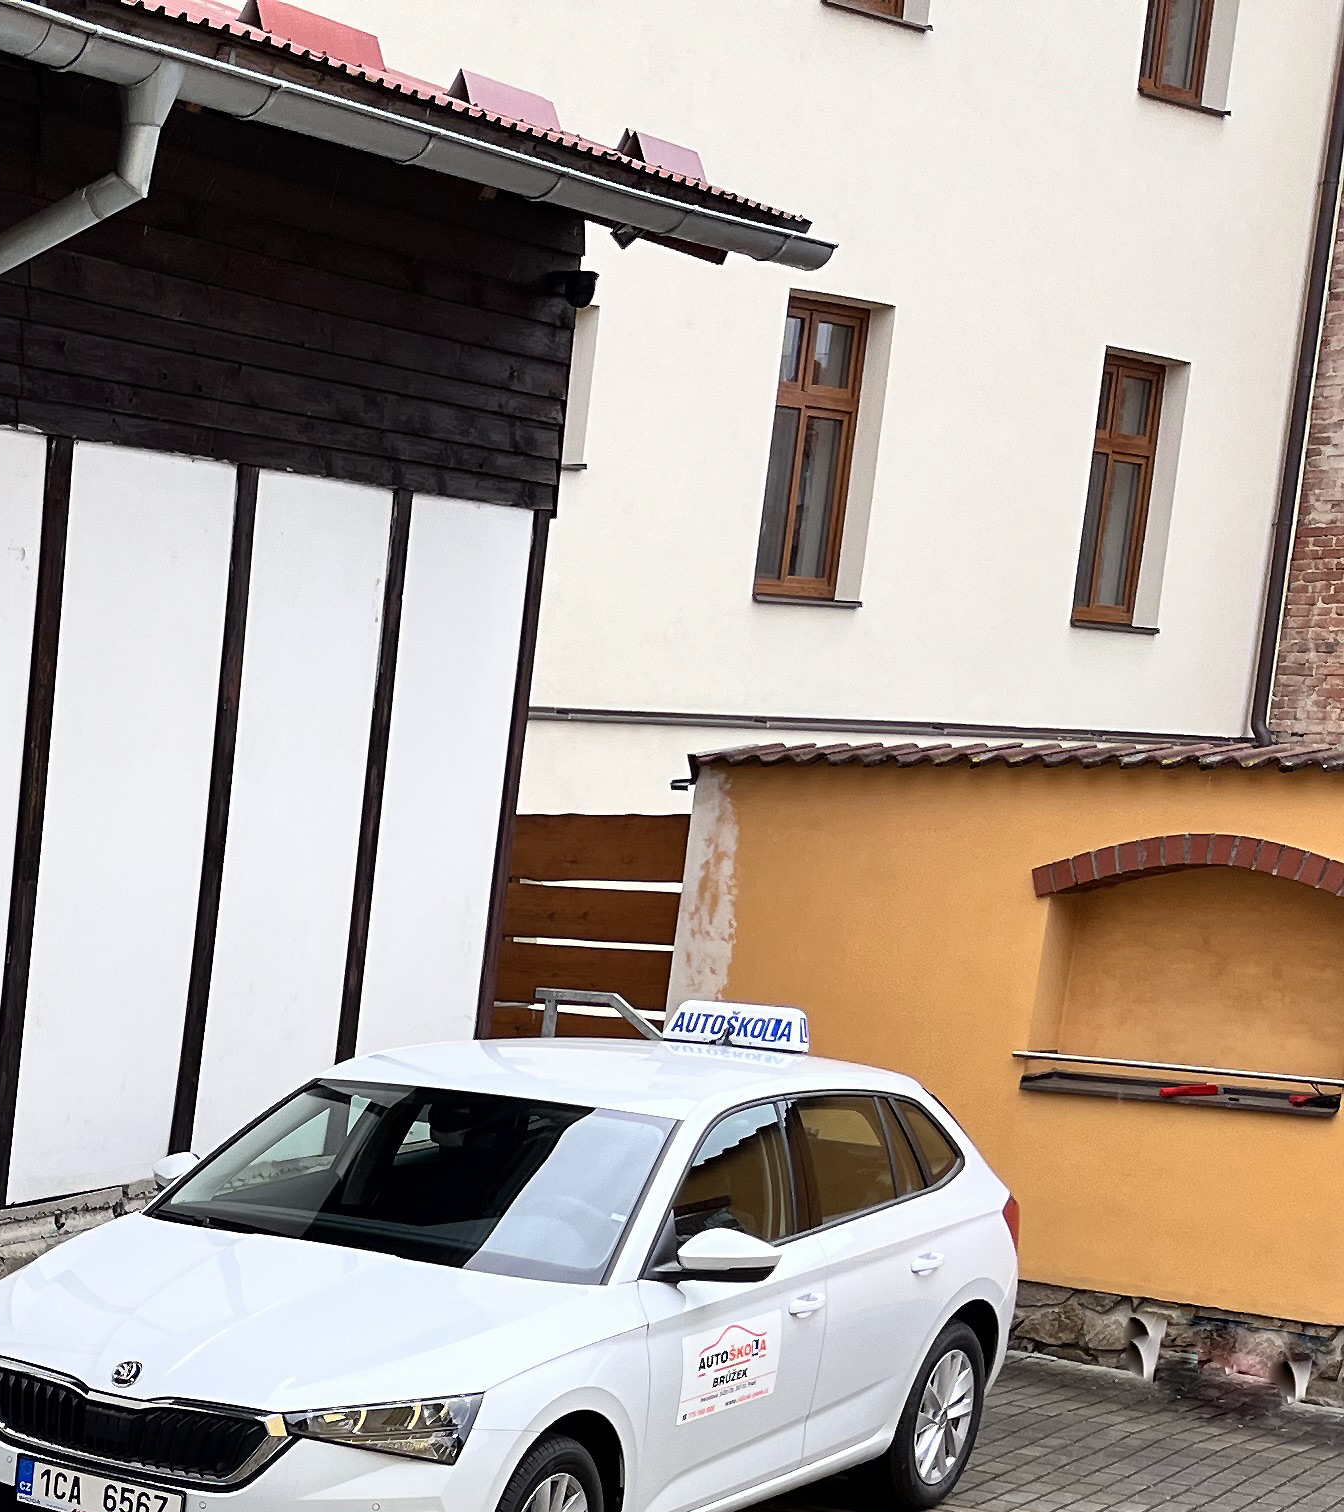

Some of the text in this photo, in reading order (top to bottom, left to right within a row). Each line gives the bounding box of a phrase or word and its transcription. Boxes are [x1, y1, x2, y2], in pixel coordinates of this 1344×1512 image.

[671, 1011, 792, 1042] AUTOŠKOLA
[698, 1339, 767, 1371] AUTOŠKOLA
[19, 1481, 31, 1492] CZ
[40, 1469, 81, 1505] 1CA
